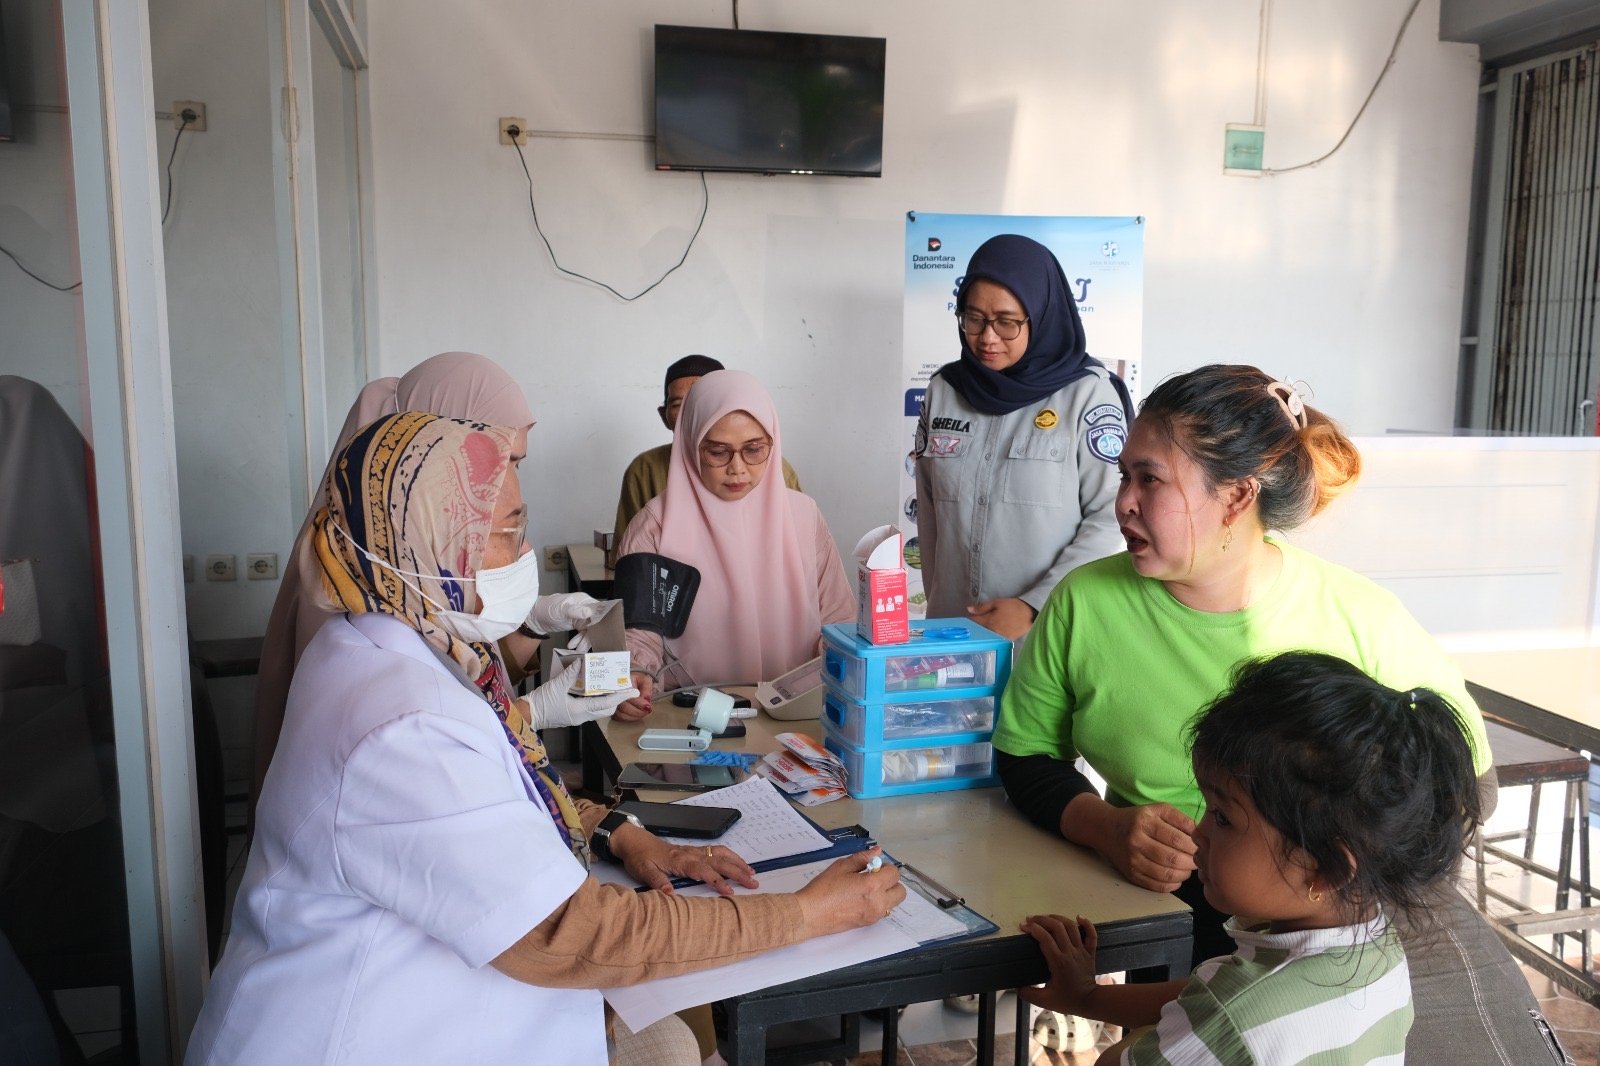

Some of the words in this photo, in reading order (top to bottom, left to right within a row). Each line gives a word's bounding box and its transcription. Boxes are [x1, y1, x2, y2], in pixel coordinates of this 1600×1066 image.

[912, 254, 956, 262] Danantara
[913, 262, 954, 270] Indonesia
[931, 417, 970, 433] SHEILA
[666, 584, 680, 612] omron
